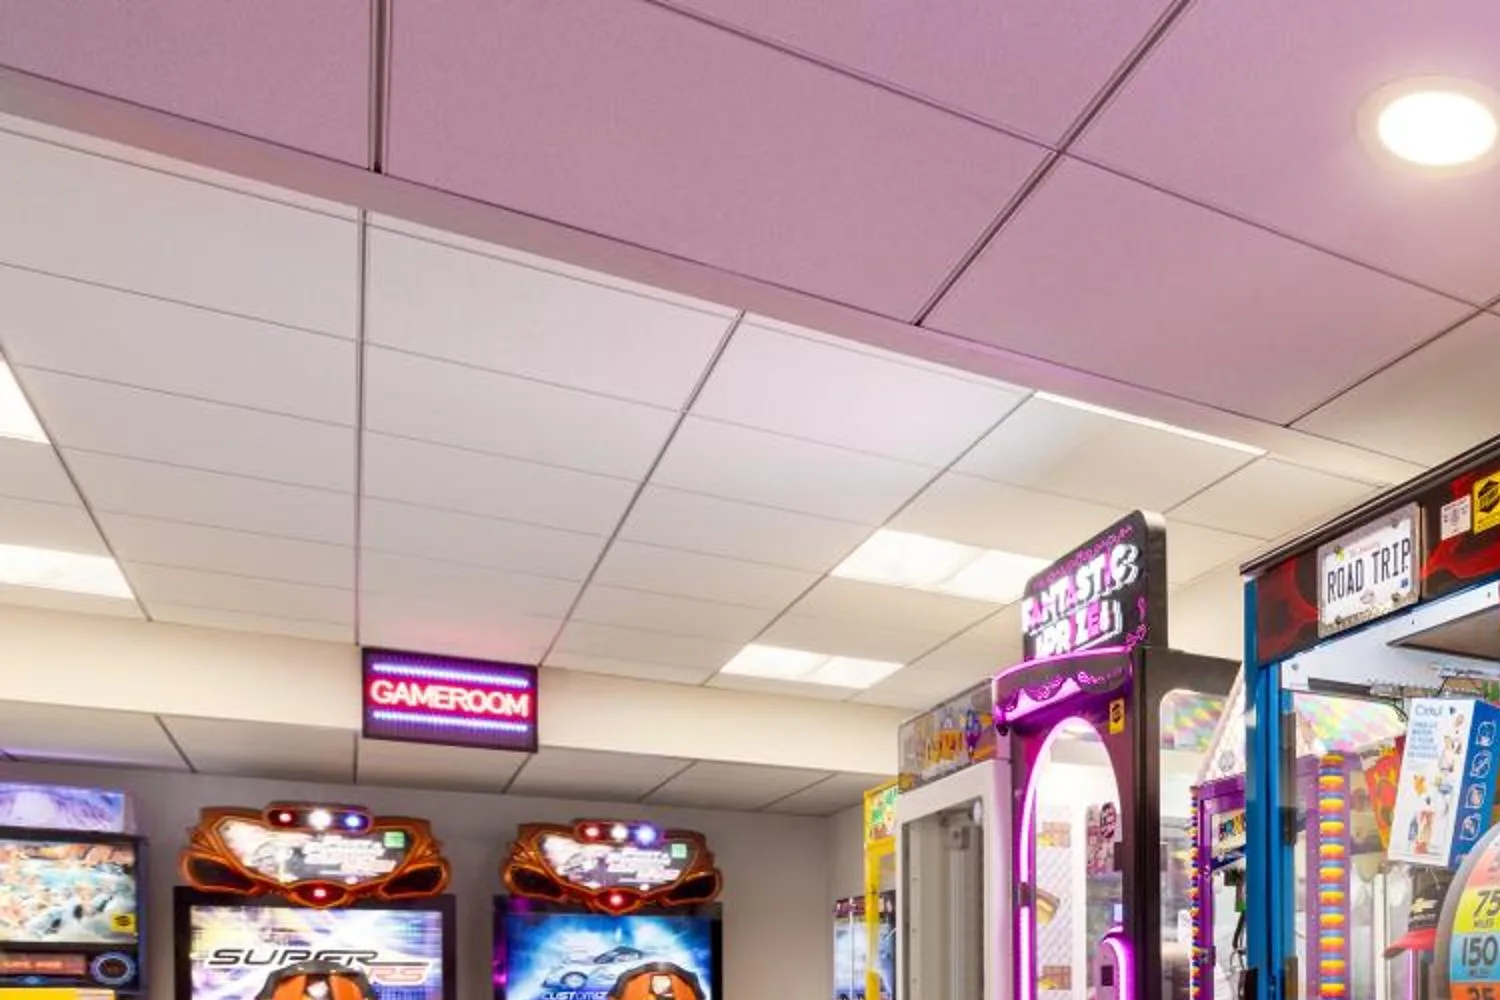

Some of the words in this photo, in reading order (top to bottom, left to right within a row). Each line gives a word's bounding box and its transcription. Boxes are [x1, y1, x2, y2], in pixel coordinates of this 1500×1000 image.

[1327, 557, 1365, 605] ROAD
[1371, 537, 1411, 585] TRIP
[370, 679, 529, 718] GAMEROOM
[208, 948, 379, 966] SUPER
[1461, 936, 1499, 967] 150
